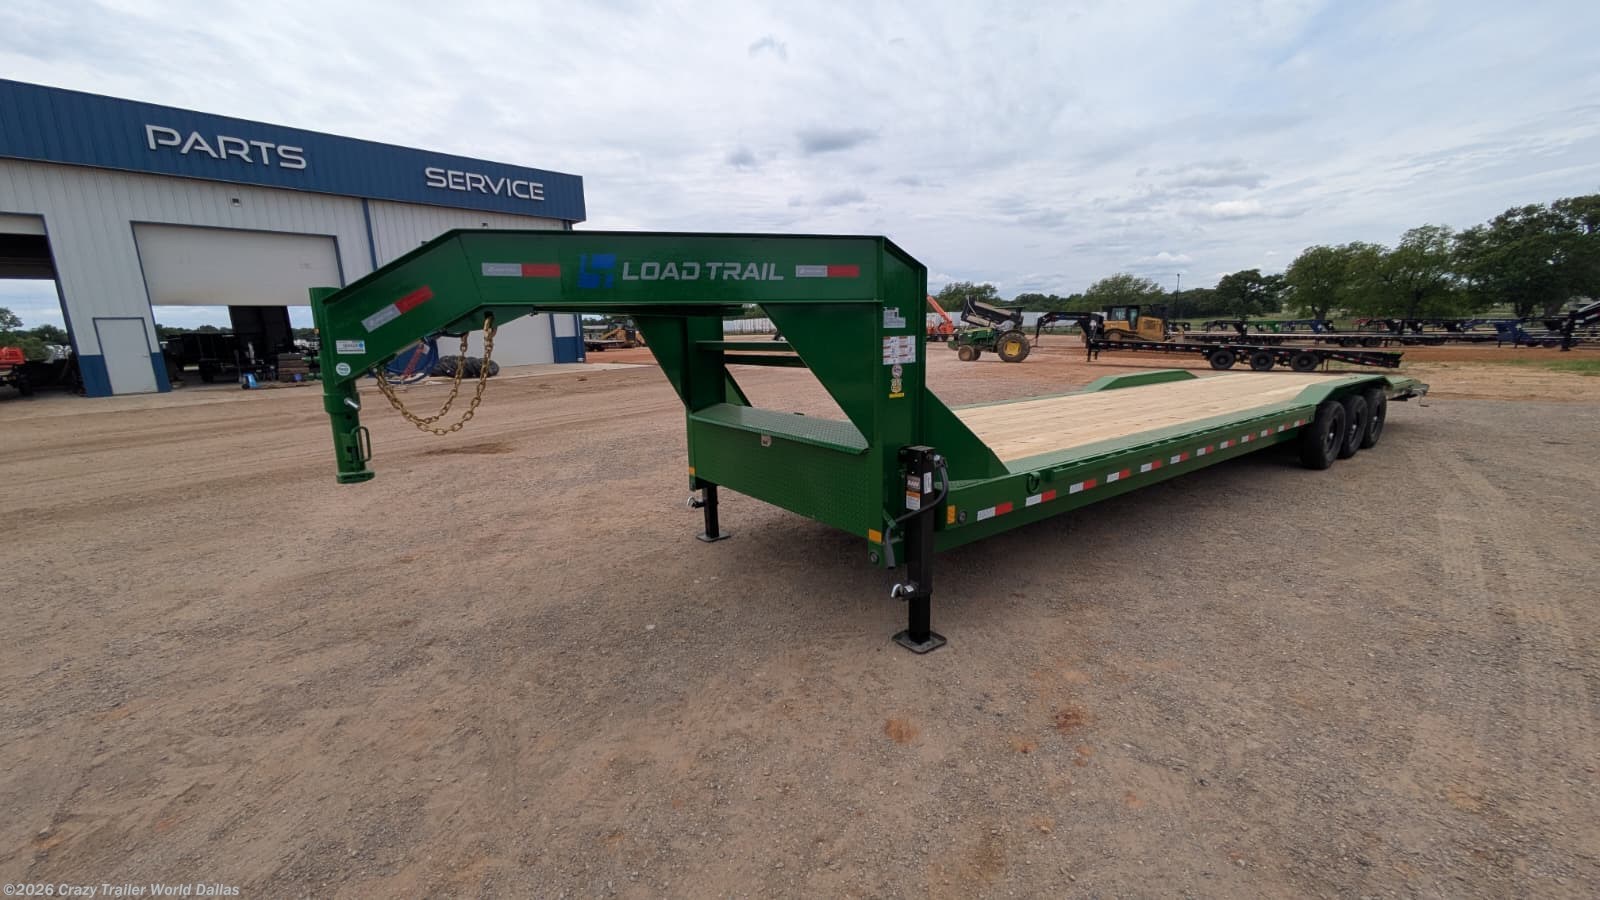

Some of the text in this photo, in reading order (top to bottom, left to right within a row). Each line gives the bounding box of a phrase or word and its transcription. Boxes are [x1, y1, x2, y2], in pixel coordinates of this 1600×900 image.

[145, 124, 307, 170] PARTS
[425, 167, 545, 201] SERVICE
[622, 262, 784, 281] LOAD TRAIL
